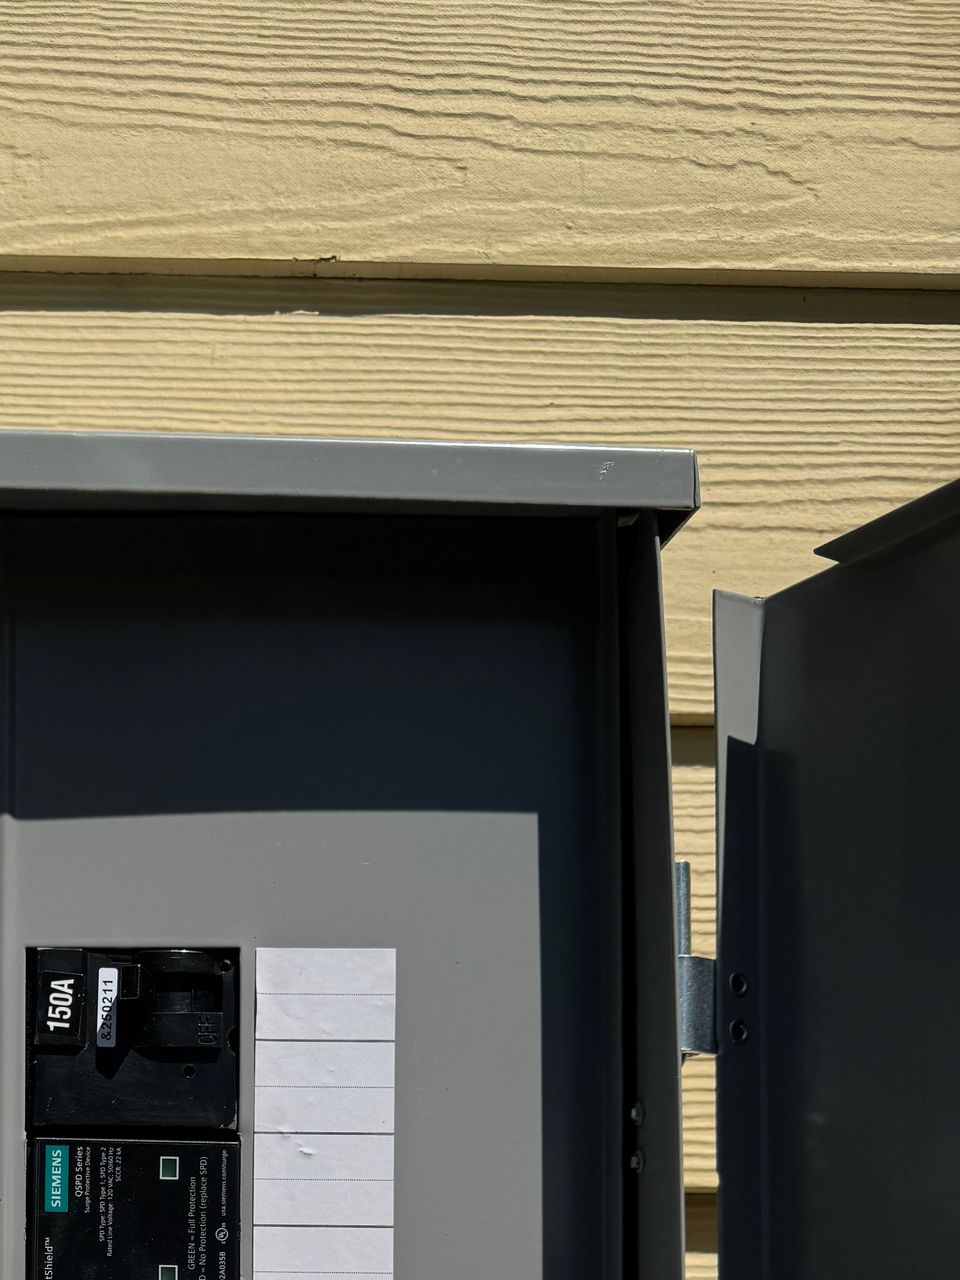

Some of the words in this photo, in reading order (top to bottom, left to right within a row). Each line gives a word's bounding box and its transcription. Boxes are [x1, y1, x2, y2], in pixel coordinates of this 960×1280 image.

[46, 979, 74, 1031] 150A
[101, 980, 113, 1040] &250211
[198, 1015, 217, 1045] OFF
[75, 1147, 83, 1171] Series
[116, 1147, 122, 1155] kA
[116, 1156, 121, 1164] 22
[52, 1150, 61, 1207] SIEMENS
[75, 1174, 84, 1197] QSPD
[199, 1177, 208, 1209] (replace
[188, 1176, 196, 1217] Protection
[199, 1211, 207, 1251] Protection
[188, 1243, 196, 1269] GREEN
[199, 1254, 206, 1265] No
